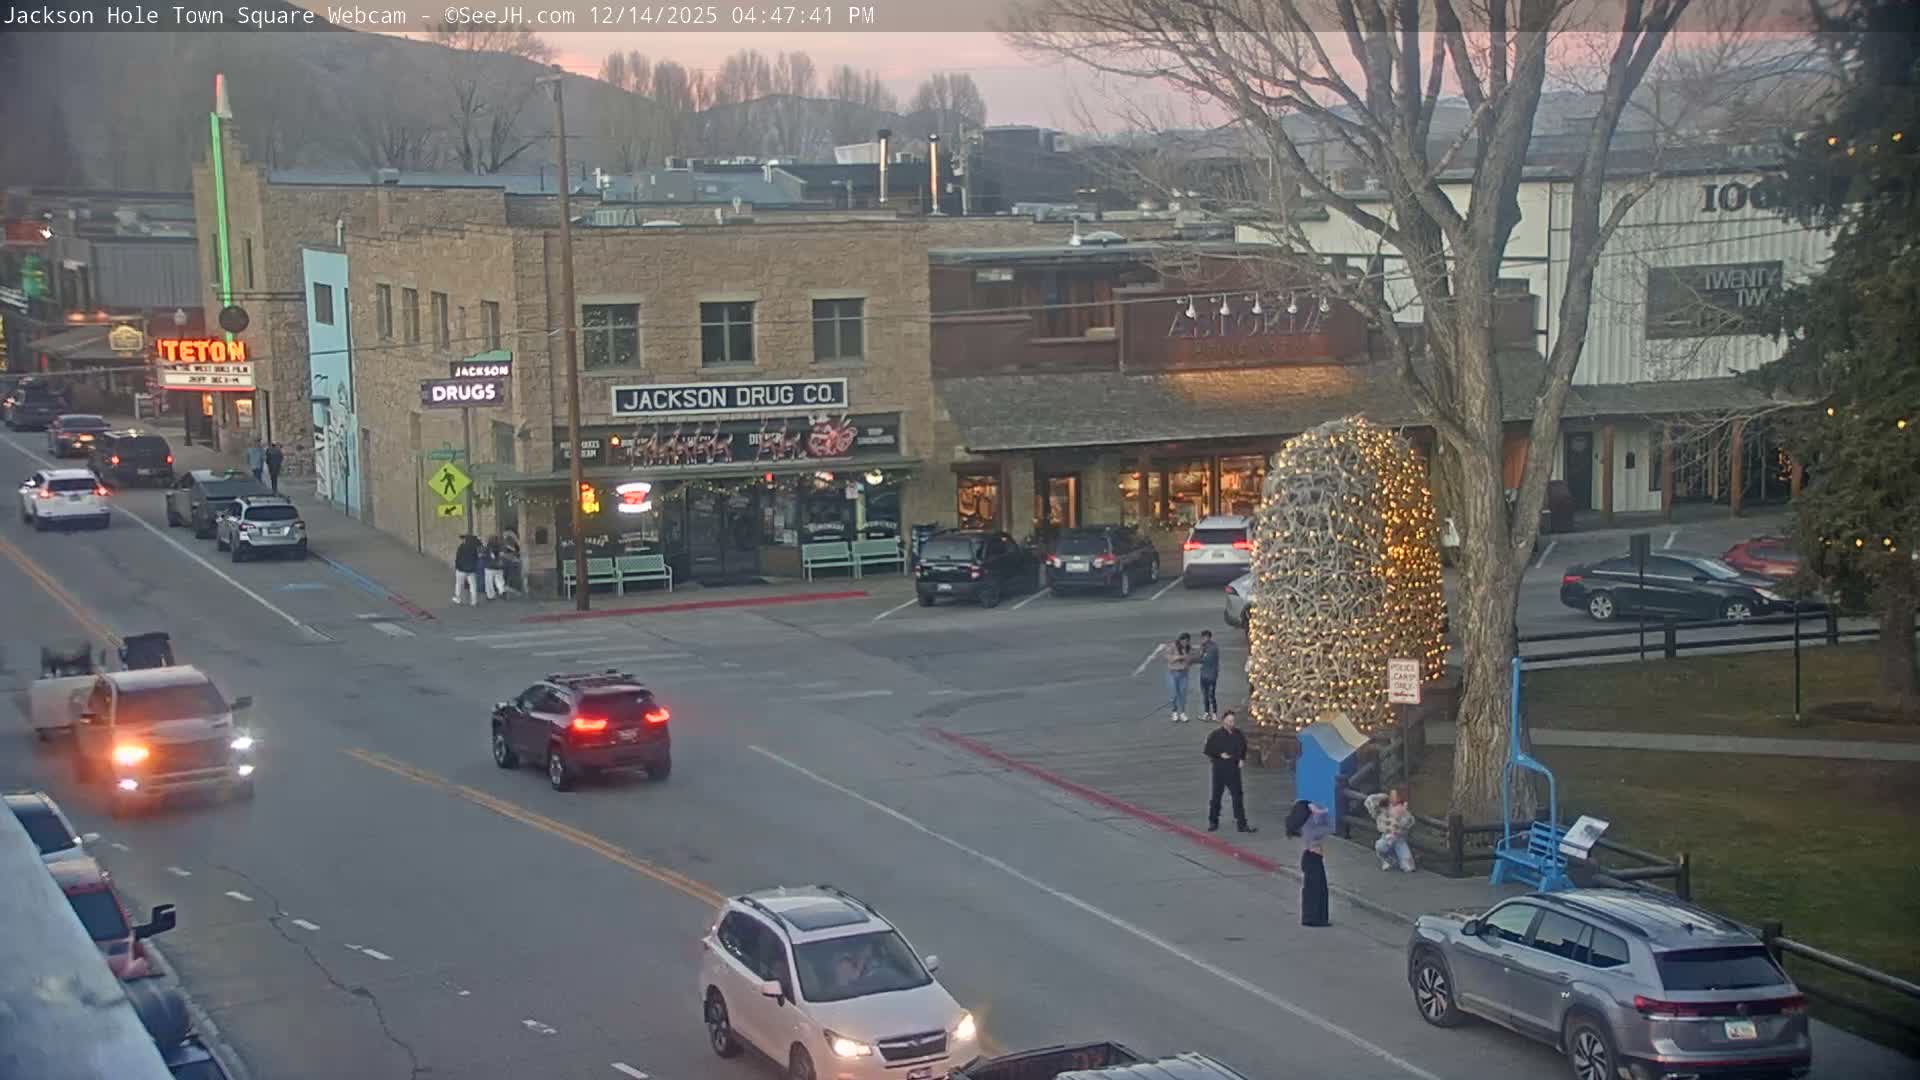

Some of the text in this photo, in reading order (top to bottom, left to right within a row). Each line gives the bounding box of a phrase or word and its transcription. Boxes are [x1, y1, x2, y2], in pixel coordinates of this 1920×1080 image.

[1705, 268, 1778, 290] TWENTY
[163, 340, 245, 362] TETON
[455, 366, 509, 377] JACKSON
[432, 384, 496, 402] DRUGS
[624, 383, 836, 409] JACKSON DRUG CO.
